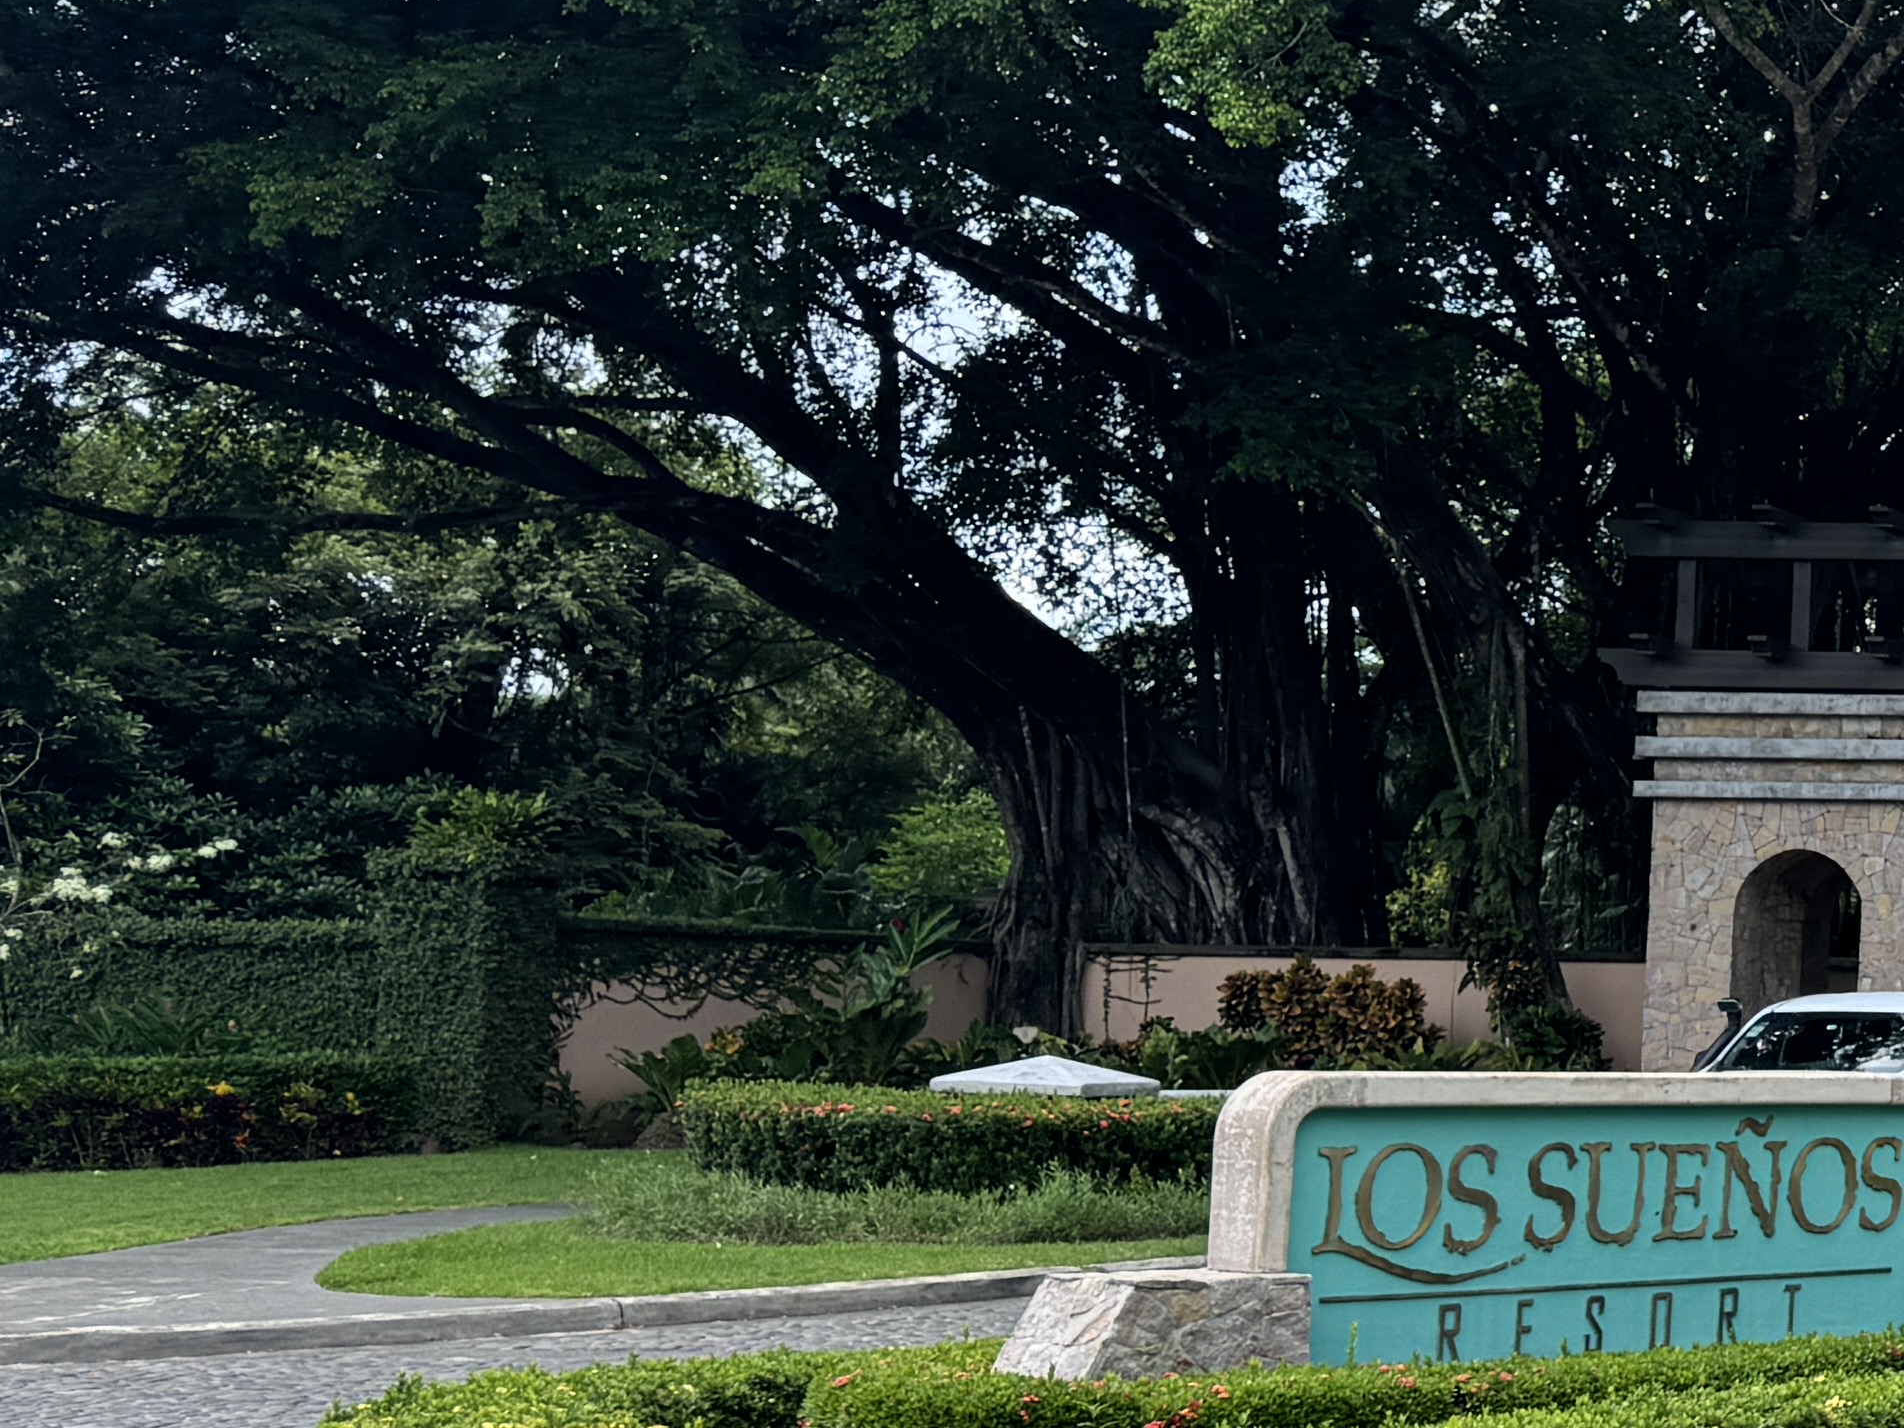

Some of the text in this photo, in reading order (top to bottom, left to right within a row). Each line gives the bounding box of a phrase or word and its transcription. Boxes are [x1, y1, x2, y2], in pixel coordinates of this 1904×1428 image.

[1311, 1115, 1904, 1284] LOS SUEÑOS
[1436, 1283, 1803, 1362] RESORT
